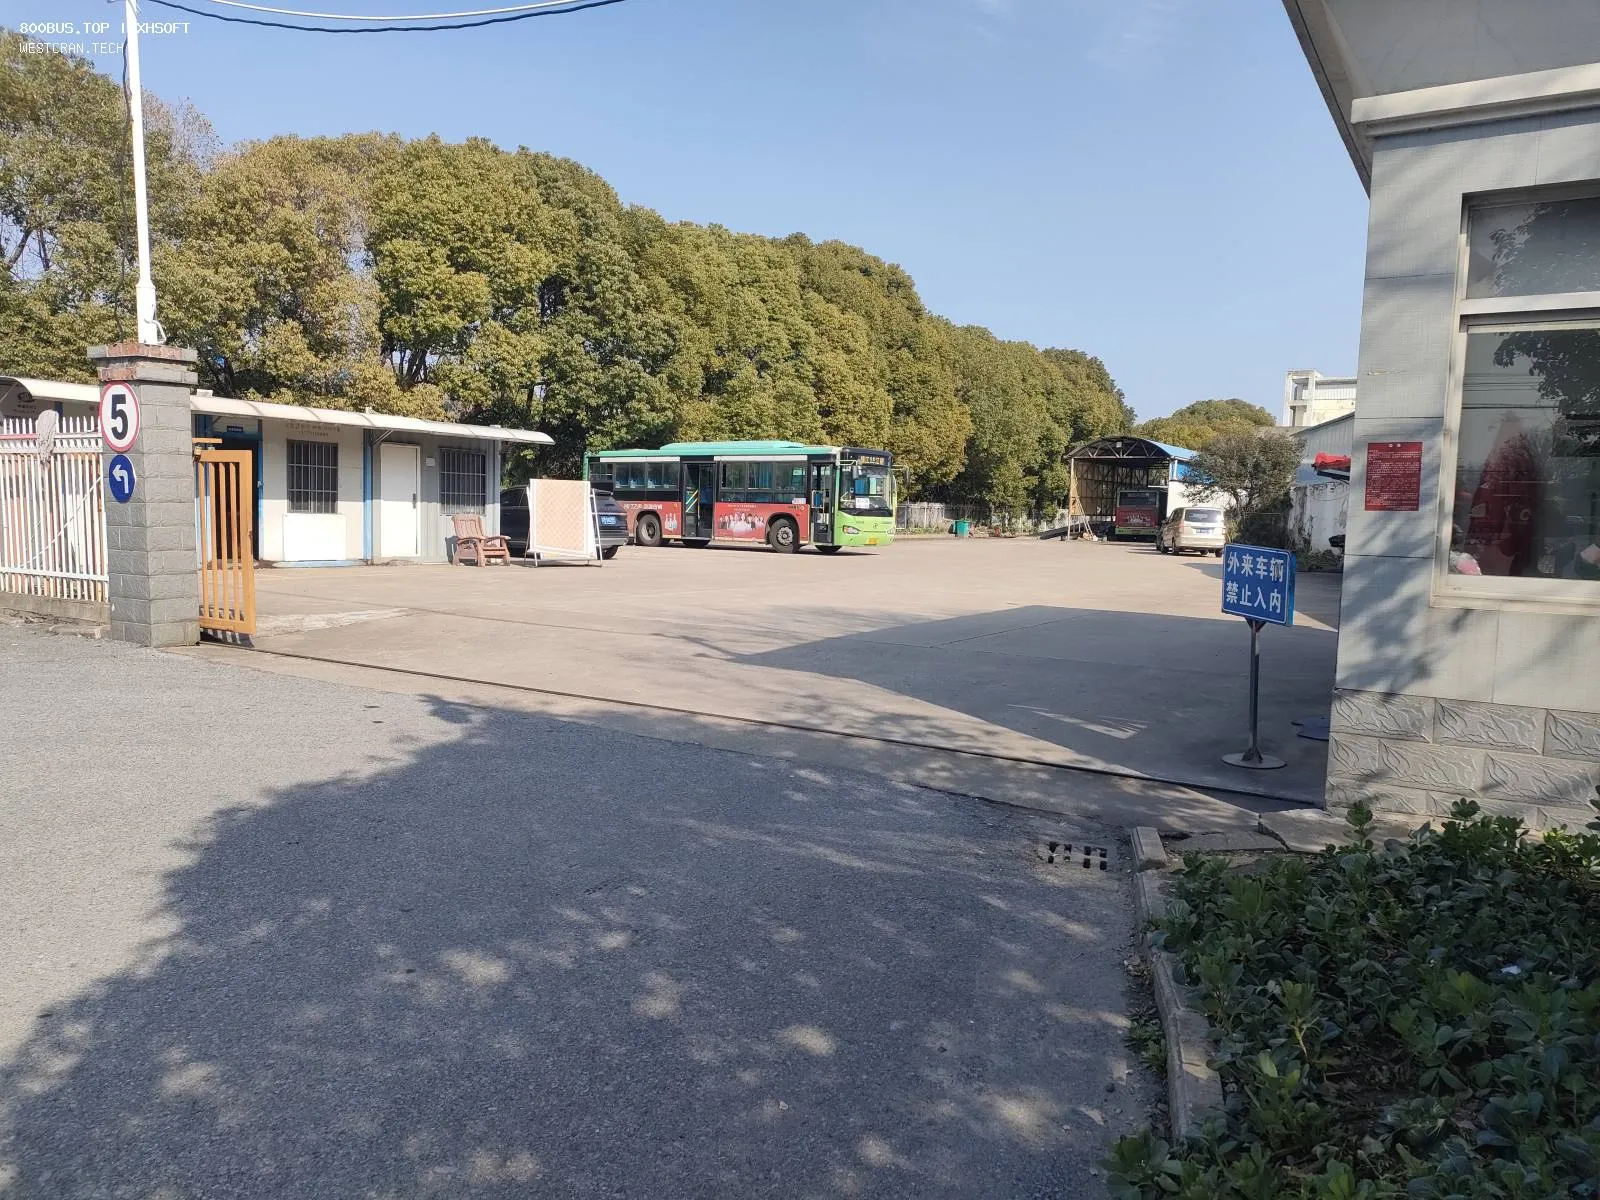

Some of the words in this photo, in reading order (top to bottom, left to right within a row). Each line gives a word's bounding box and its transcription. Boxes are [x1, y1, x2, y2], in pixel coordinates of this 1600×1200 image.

[111, 393, 129, 441] 5
[1227, 551, 1285, 583] 外来车辆
[1225, 580, 1282, 614] 禁止入内
